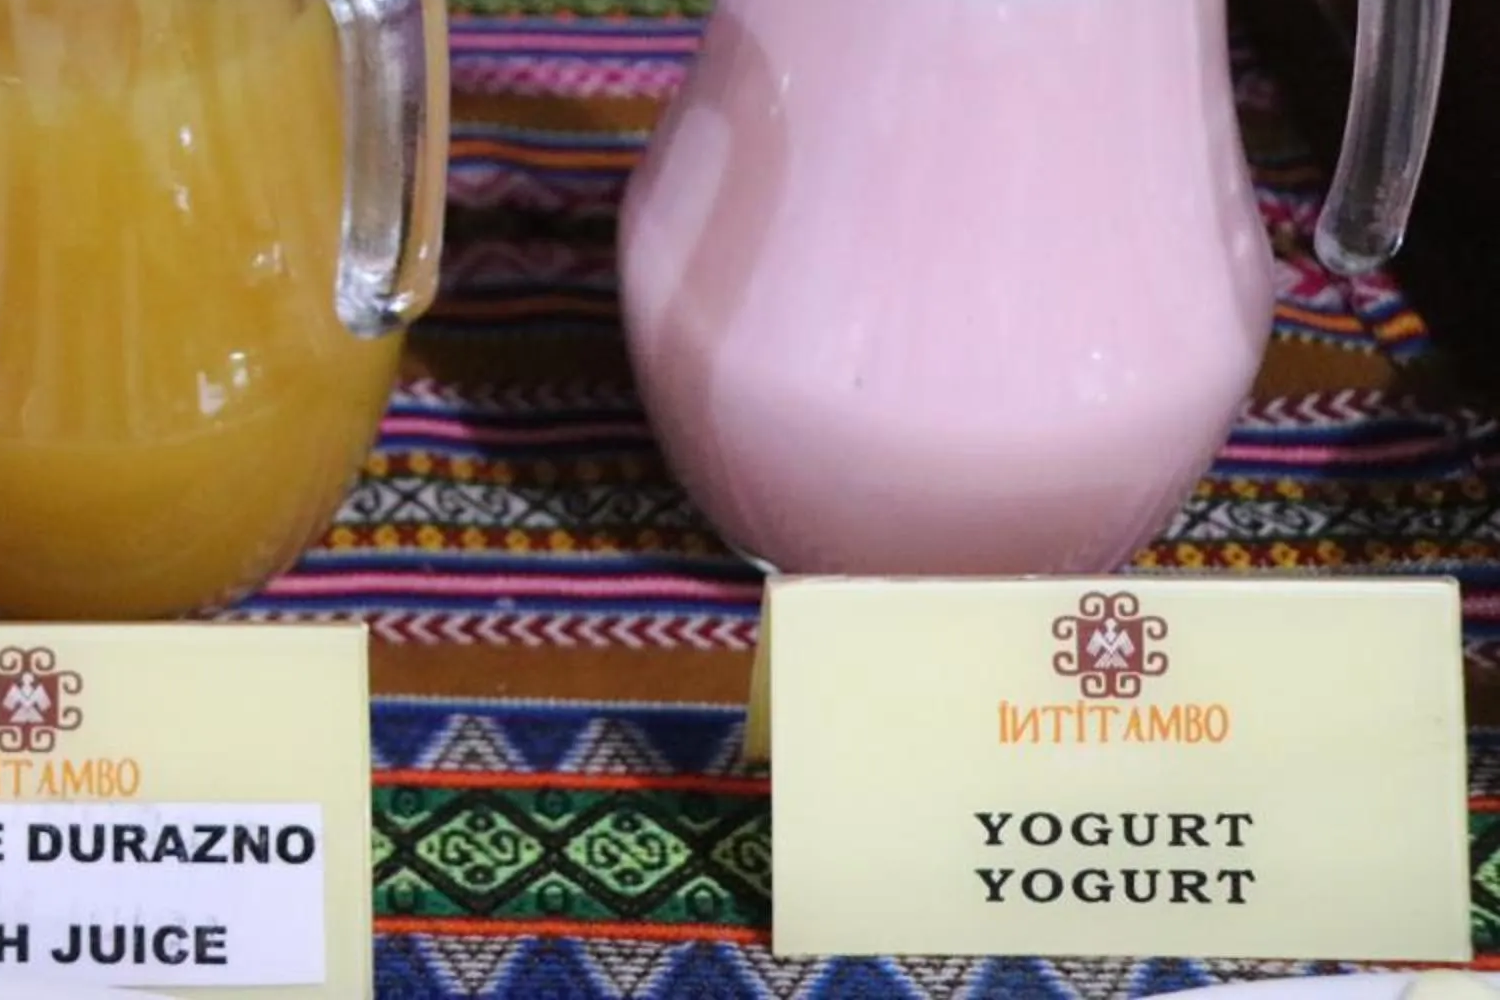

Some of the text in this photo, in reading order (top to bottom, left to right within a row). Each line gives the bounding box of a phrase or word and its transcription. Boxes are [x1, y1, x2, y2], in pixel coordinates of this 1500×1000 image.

[27, 824, 315, 864] DURAZNO
[974, 812, 1254, 848] YOGURT
[974, 868, 1256, 905] YOGURT
[51, 925, 227, 965] JUICE
